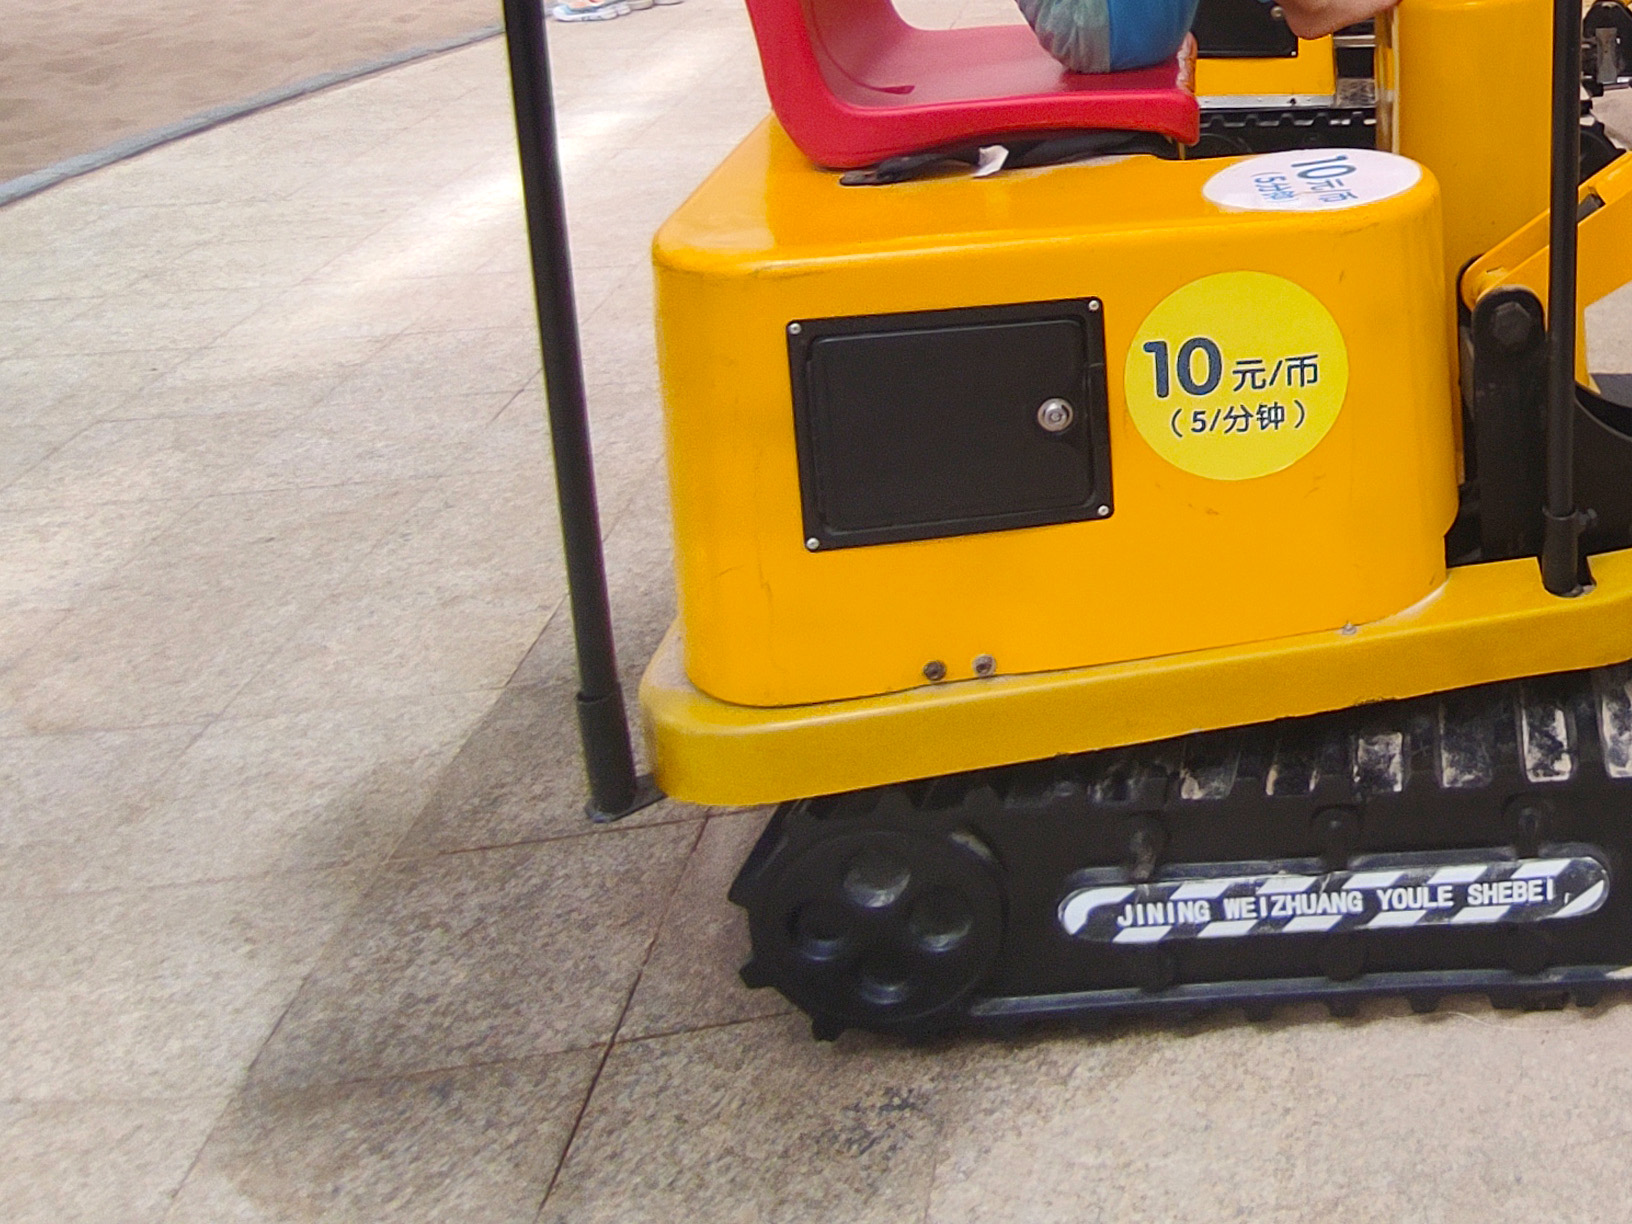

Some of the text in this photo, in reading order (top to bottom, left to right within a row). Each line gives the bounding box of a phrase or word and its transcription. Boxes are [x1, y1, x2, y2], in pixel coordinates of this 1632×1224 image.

[1117, 877, 1555, 928] JINING WEIZHUANG YOULE SHEBEI
